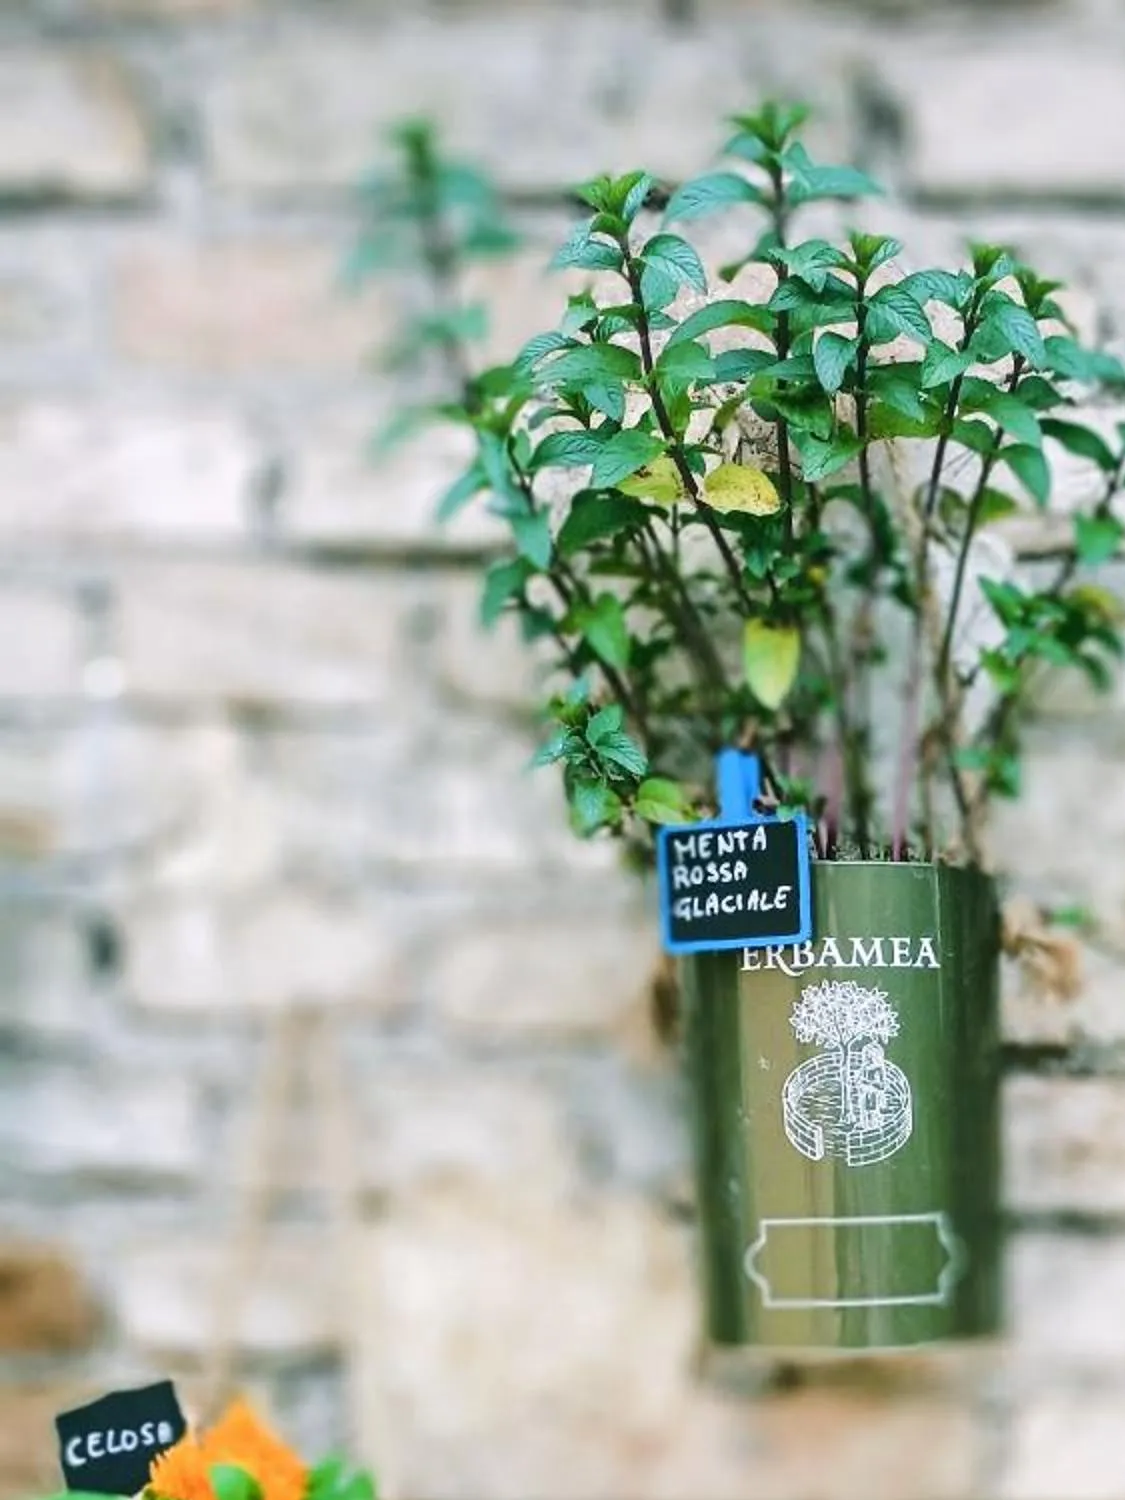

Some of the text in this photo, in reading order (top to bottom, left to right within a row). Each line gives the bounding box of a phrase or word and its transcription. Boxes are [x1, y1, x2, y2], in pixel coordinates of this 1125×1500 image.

[674, 825, 767, 860] MENTA
[673, 861, 748, 890] ROSSA
[674, 885, 792, 921] GLACIALE
[741, 937, 941, 977] ERBAMEA
[66, 1421, 173, 1466] CELOSA
